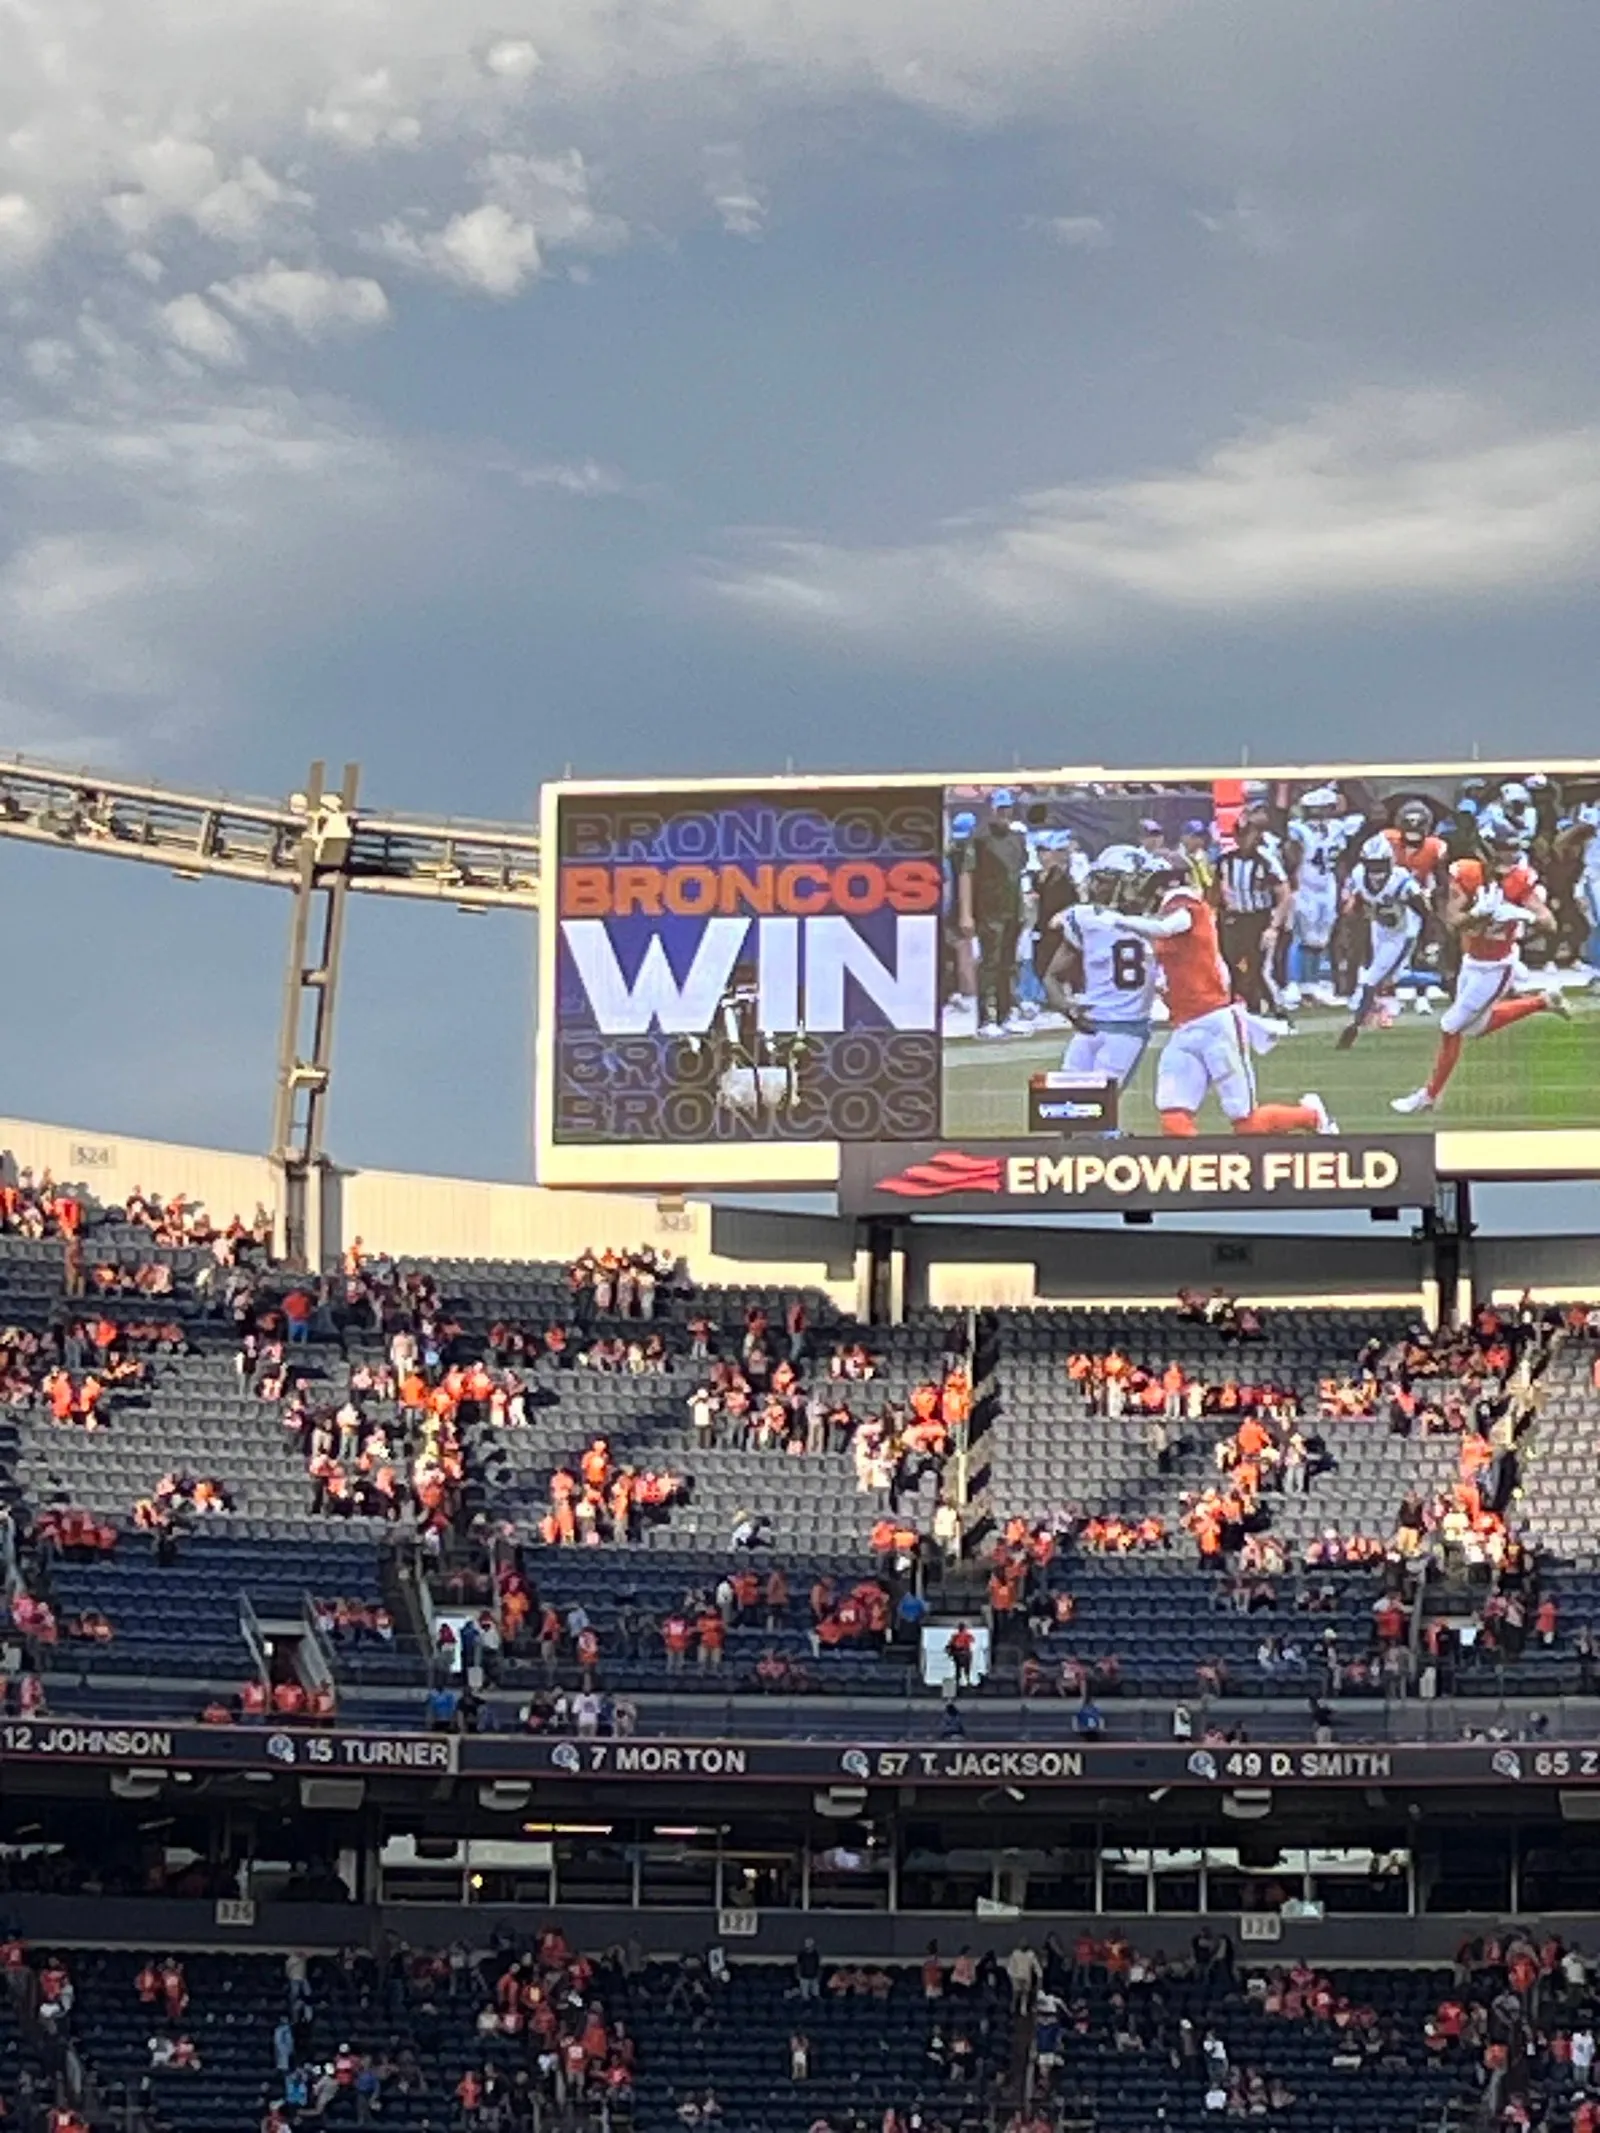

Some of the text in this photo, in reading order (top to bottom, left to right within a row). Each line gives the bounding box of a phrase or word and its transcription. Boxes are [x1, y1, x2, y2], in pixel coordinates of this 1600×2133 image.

[562, 807, 937, 862] BRONCOS
[562, 861, 941, 915] BRONCOS
[560, 915, 938, 1035] WIN
[1111, 939, 1145, 990] 8
[560, 1034, 937, 1088] BROCOS
[1007, 1151, 1399, 1193] EMPOWER FIELD
[3, 1726, 172, 1755] 12 JOHNSON
[306, 1739, 448, 1765] 15 TURNER
[590, 1747, 746, 1773] 7 MORTON
[878, 1753, 1082, 1776] 57 T. JACKSON
[1226, 1752, 1391, 1776] 49 D. SMITH
[1535, 1751, 1570, 1776] 65
